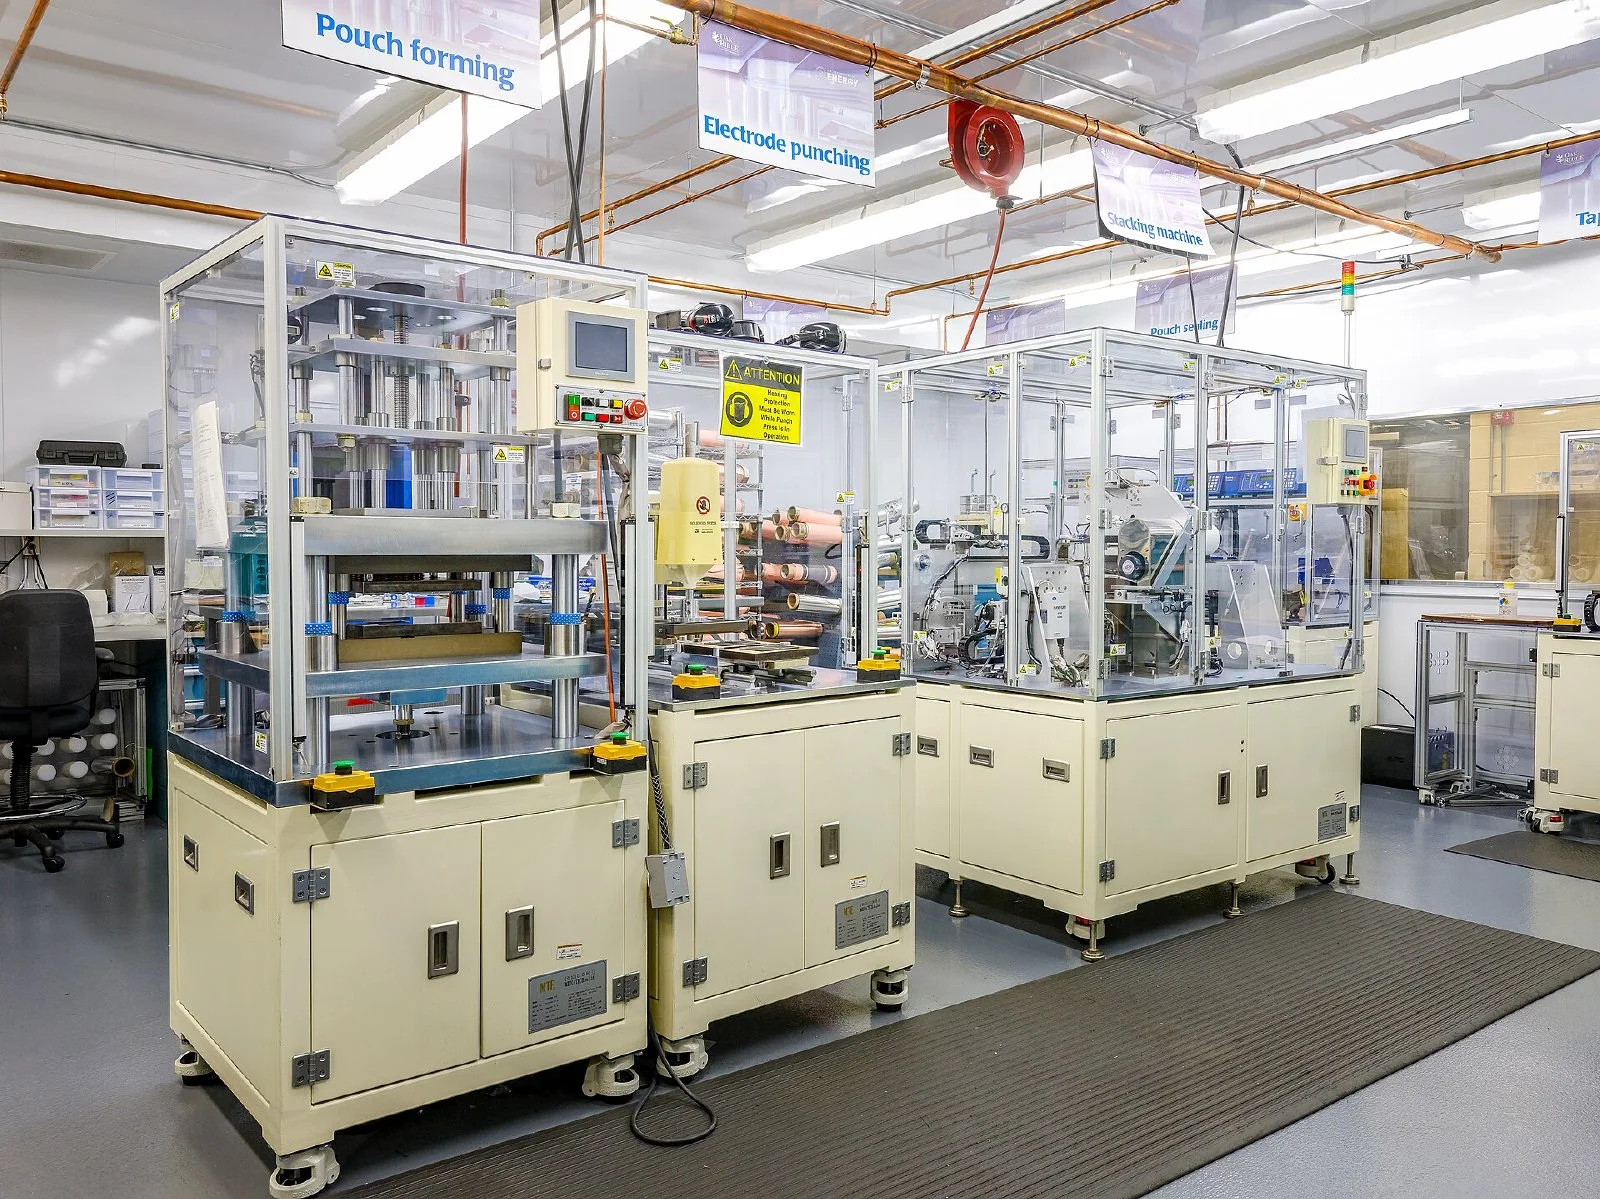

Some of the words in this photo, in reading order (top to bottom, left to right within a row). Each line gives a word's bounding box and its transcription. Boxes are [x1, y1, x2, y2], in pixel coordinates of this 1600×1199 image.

[316, 12, 403, 58] Pouch
[409, 38, 515, 92] forming
[827, 72, 859, 87] ENERGY
[704, 114, 786, 153] Electrode
[790, 140, 871, 176] punching
[1107, 211, 1155, 240] Stacking
[1156, 225, 1204, 246] machine
[1150, 323, 1181, 336] Pouch
[744, 366, 800, 386] ATTENTION
[767, 389, 788, 400] Hearing
[763, 398, 791, 407] Protection
[759, 405, 772, 414] Must
[781, 408, 795, 416] Worn
[760, 414, 776, 422] While
[776, 416, 793, 425] Punch
[763, 423, 777, 431] Press
[763, 431, 789, 441] Operation
